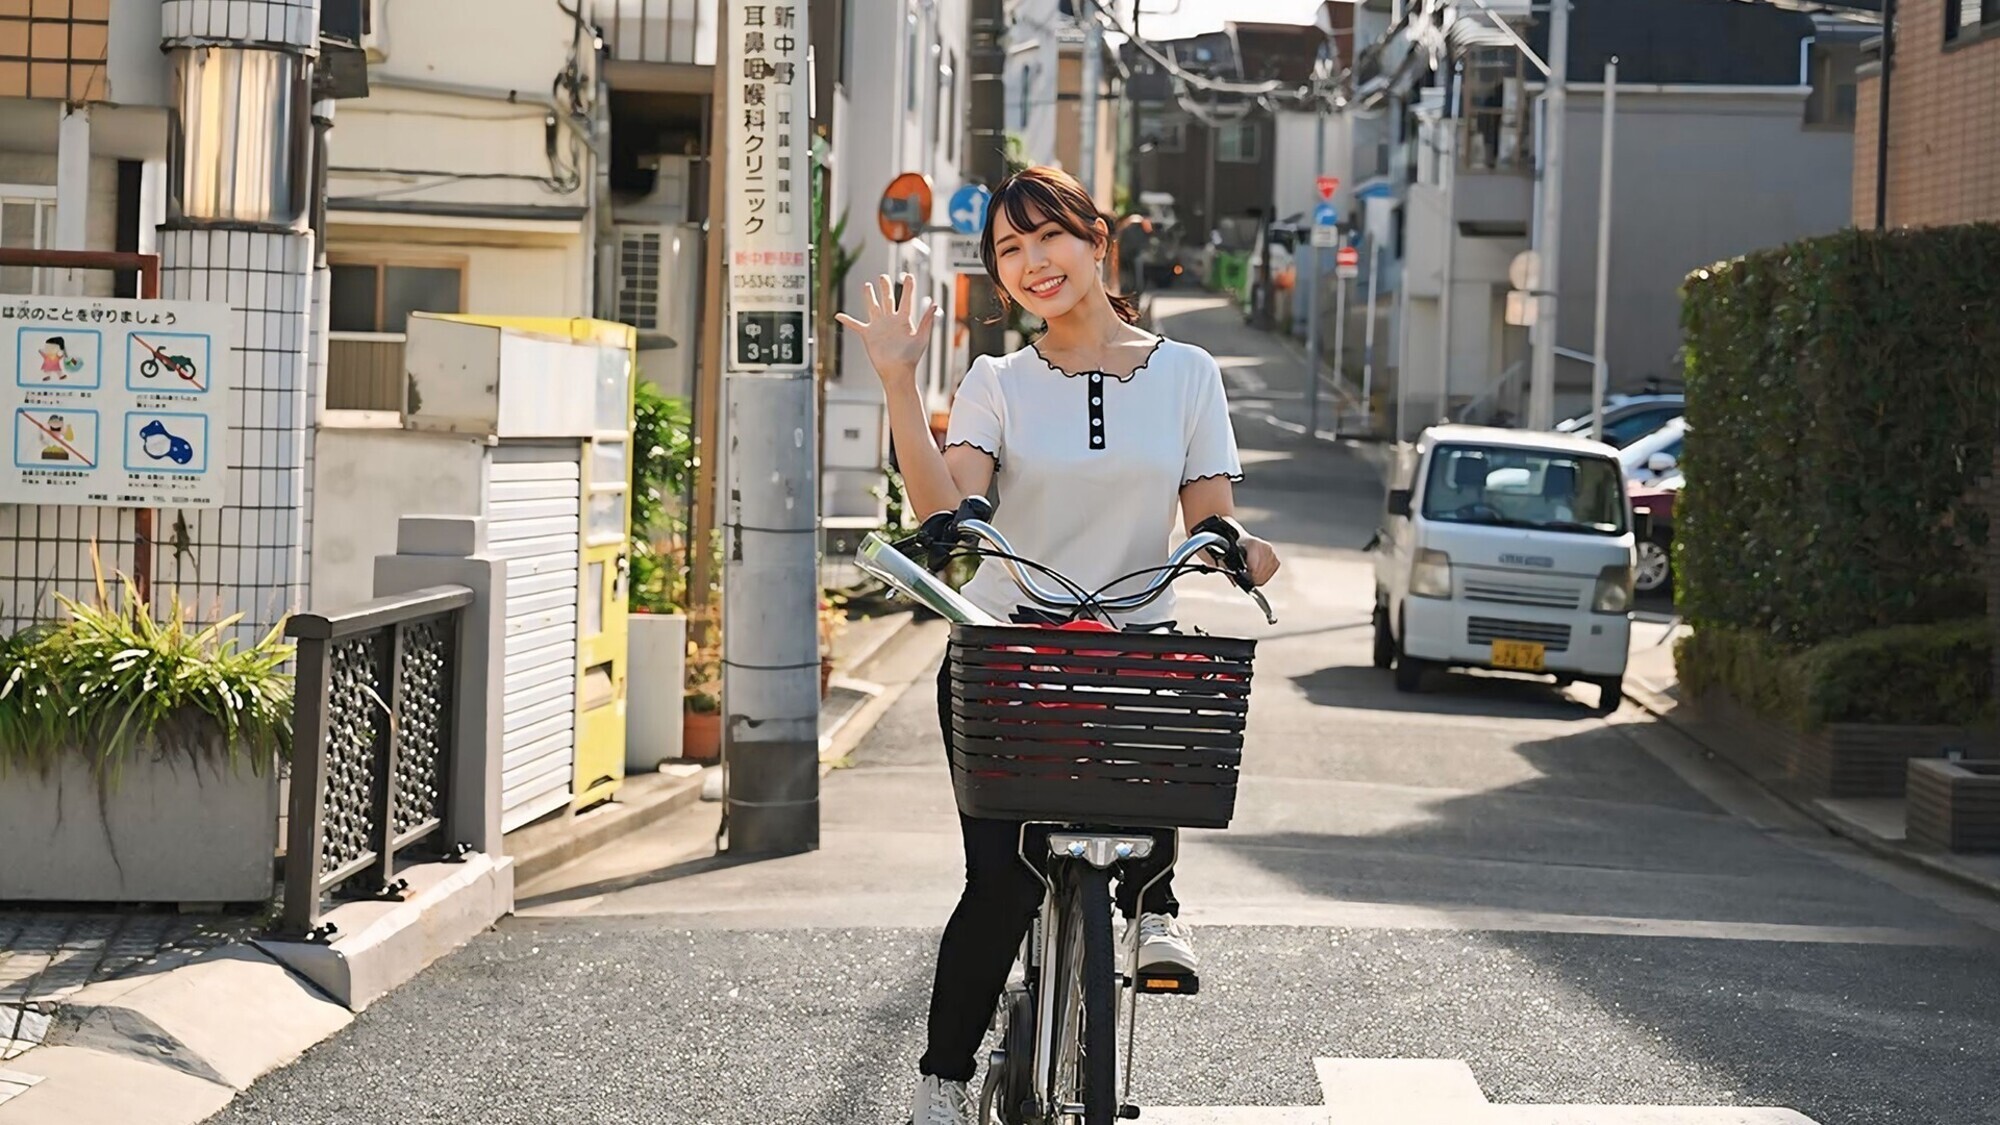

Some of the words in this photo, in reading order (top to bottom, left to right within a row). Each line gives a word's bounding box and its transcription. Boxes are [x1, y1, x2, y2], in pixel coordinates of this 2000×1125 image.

[773, 6, 795, 86] 新中野
[2, 306, 177, 325] は次のことを守りましょう
[747, 343, 793, 360] 3-15
